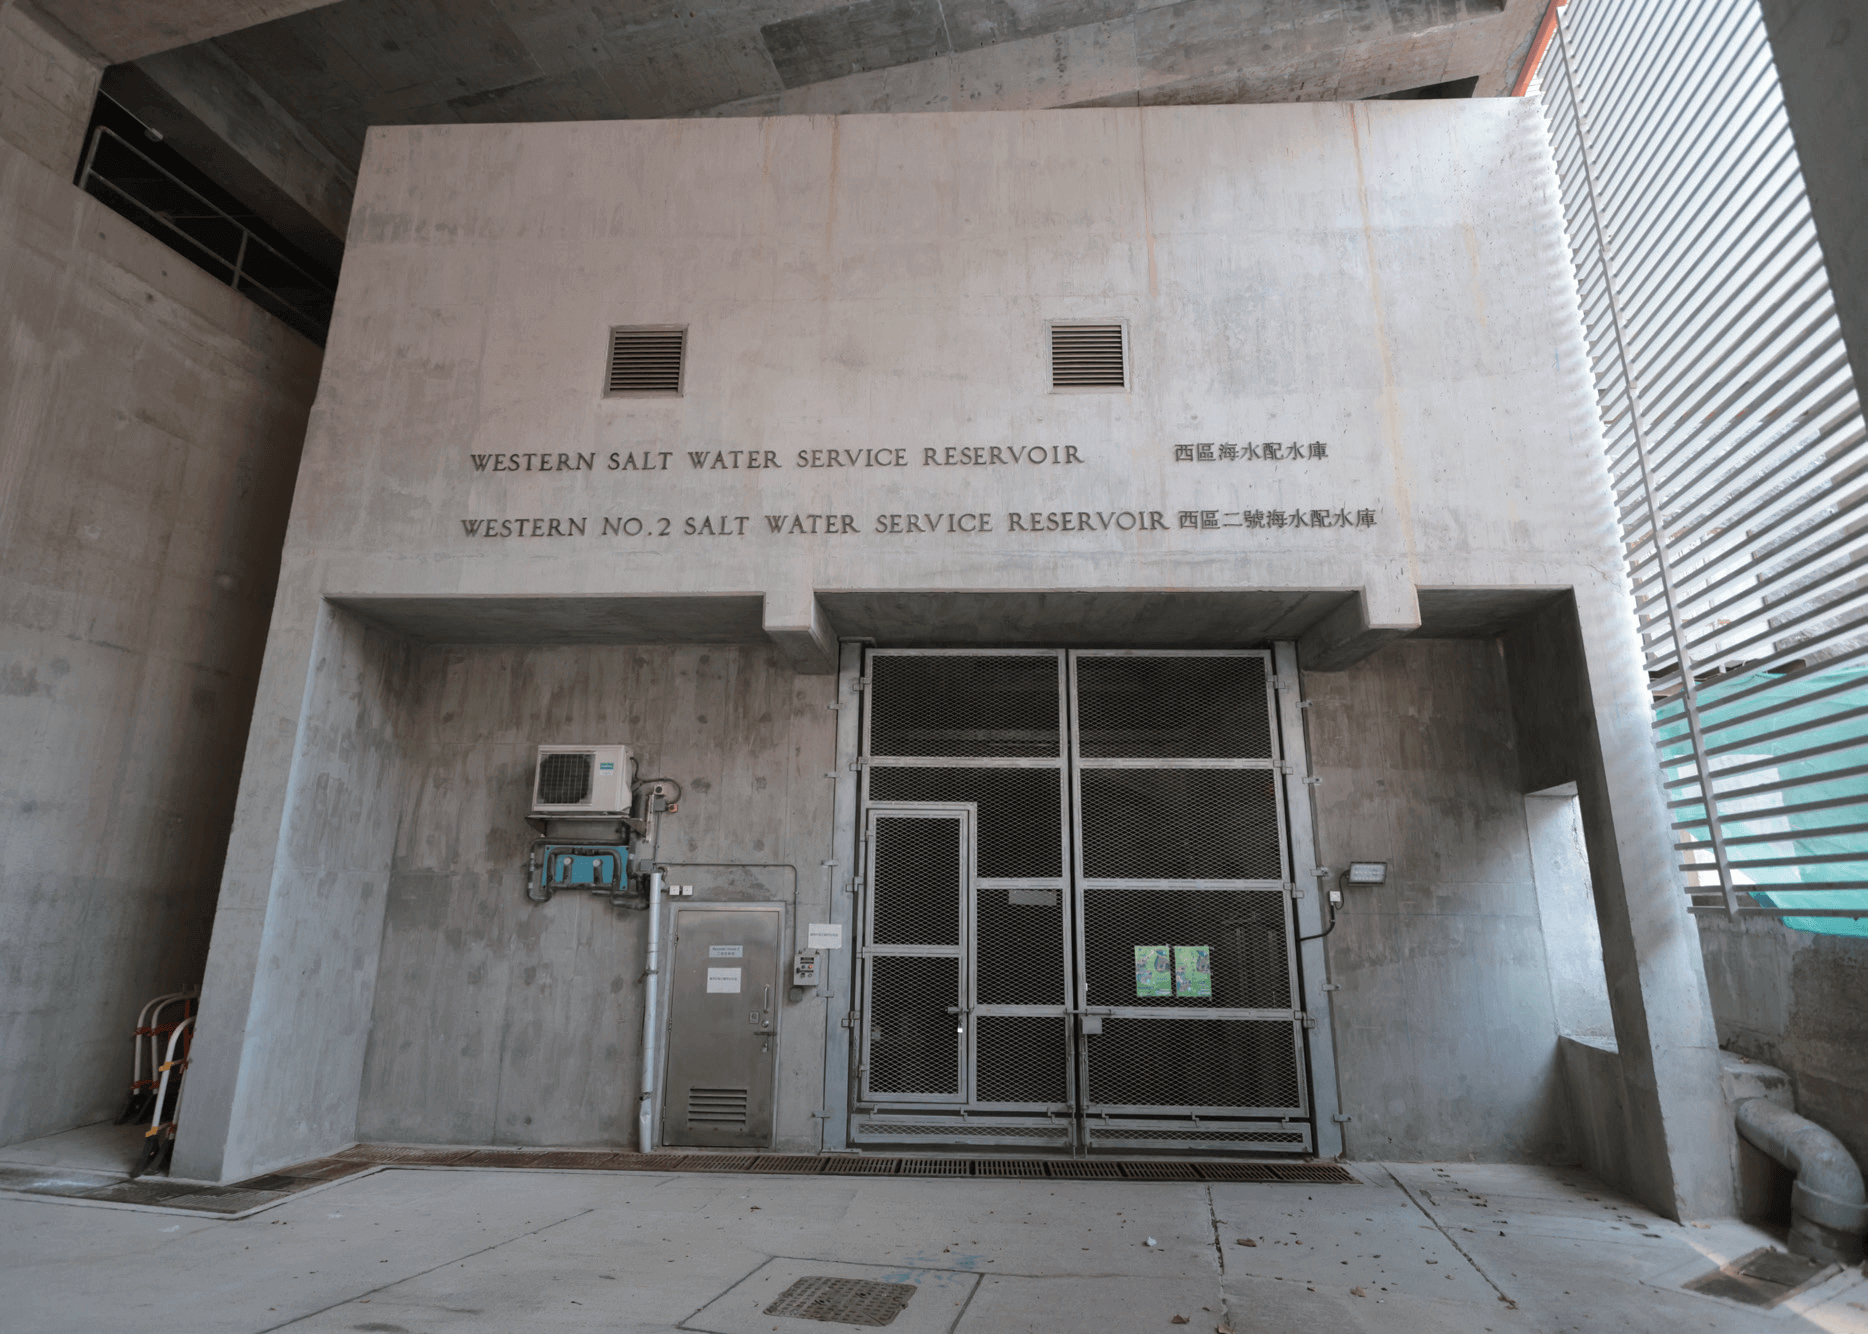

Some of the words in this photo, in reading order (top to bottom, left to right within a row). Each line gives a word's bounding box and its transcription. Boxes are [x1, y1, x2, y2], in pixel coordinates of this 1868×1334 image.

[470, 452, 596, 472] WESTERN
[607, 451, 674, 471] SALT
[687, 450, 783, 470] WATER
[796, 448, 909, 468] SERVICE
[922, 445, 1085, 466] RESERVOIR
[1174, 441, 1329, 462] 西區海水配水庫
[461, 517, 588, 538] WESTERN
[601, 516, 671, 537] NO.2
[684, 515, 750, 536] SALT
[765, 514, 861, 535] WATER
[875, 512, 993, 534] SERVICE
[1008, 510, 1171, 532] RESERVOIR
[1178, 508, 1378, 530] 西區二號海水配水庫
